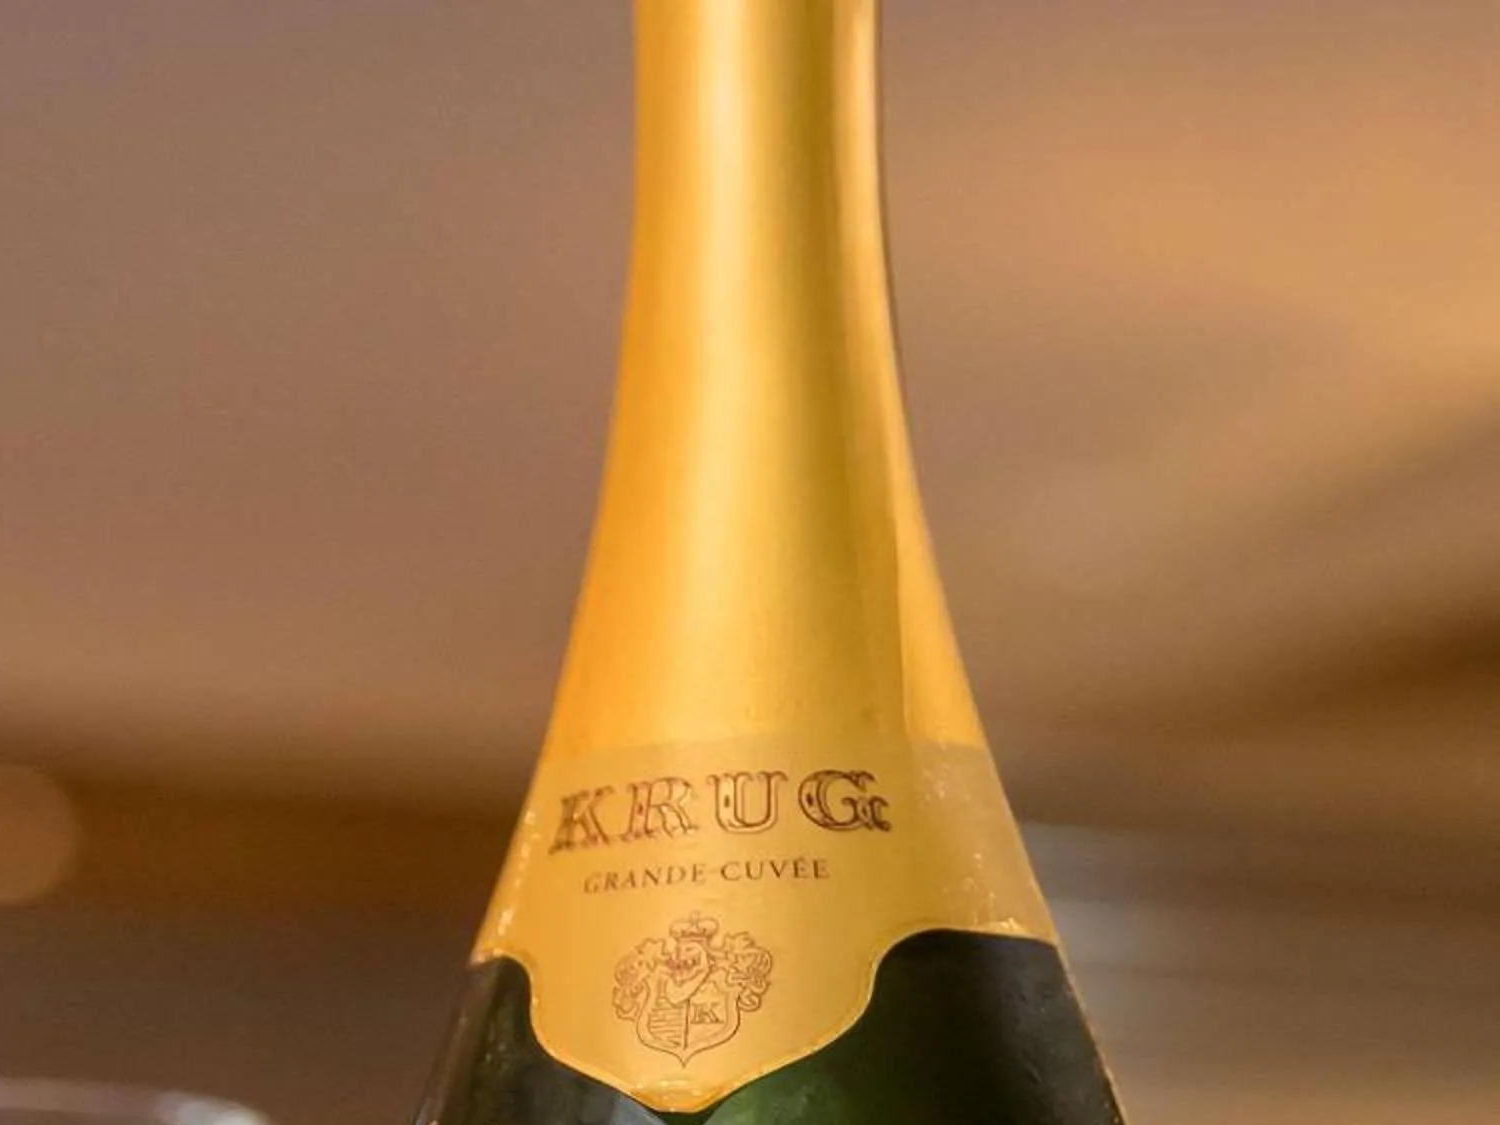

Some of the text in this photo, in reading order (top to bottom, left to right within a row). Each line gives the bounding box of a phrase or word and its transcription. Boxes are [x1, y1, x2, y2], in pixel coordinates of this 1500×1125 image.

[548, 770, 892, 853] KRUG
[583, 856, 831, 894] GRANDE CUVÉE
